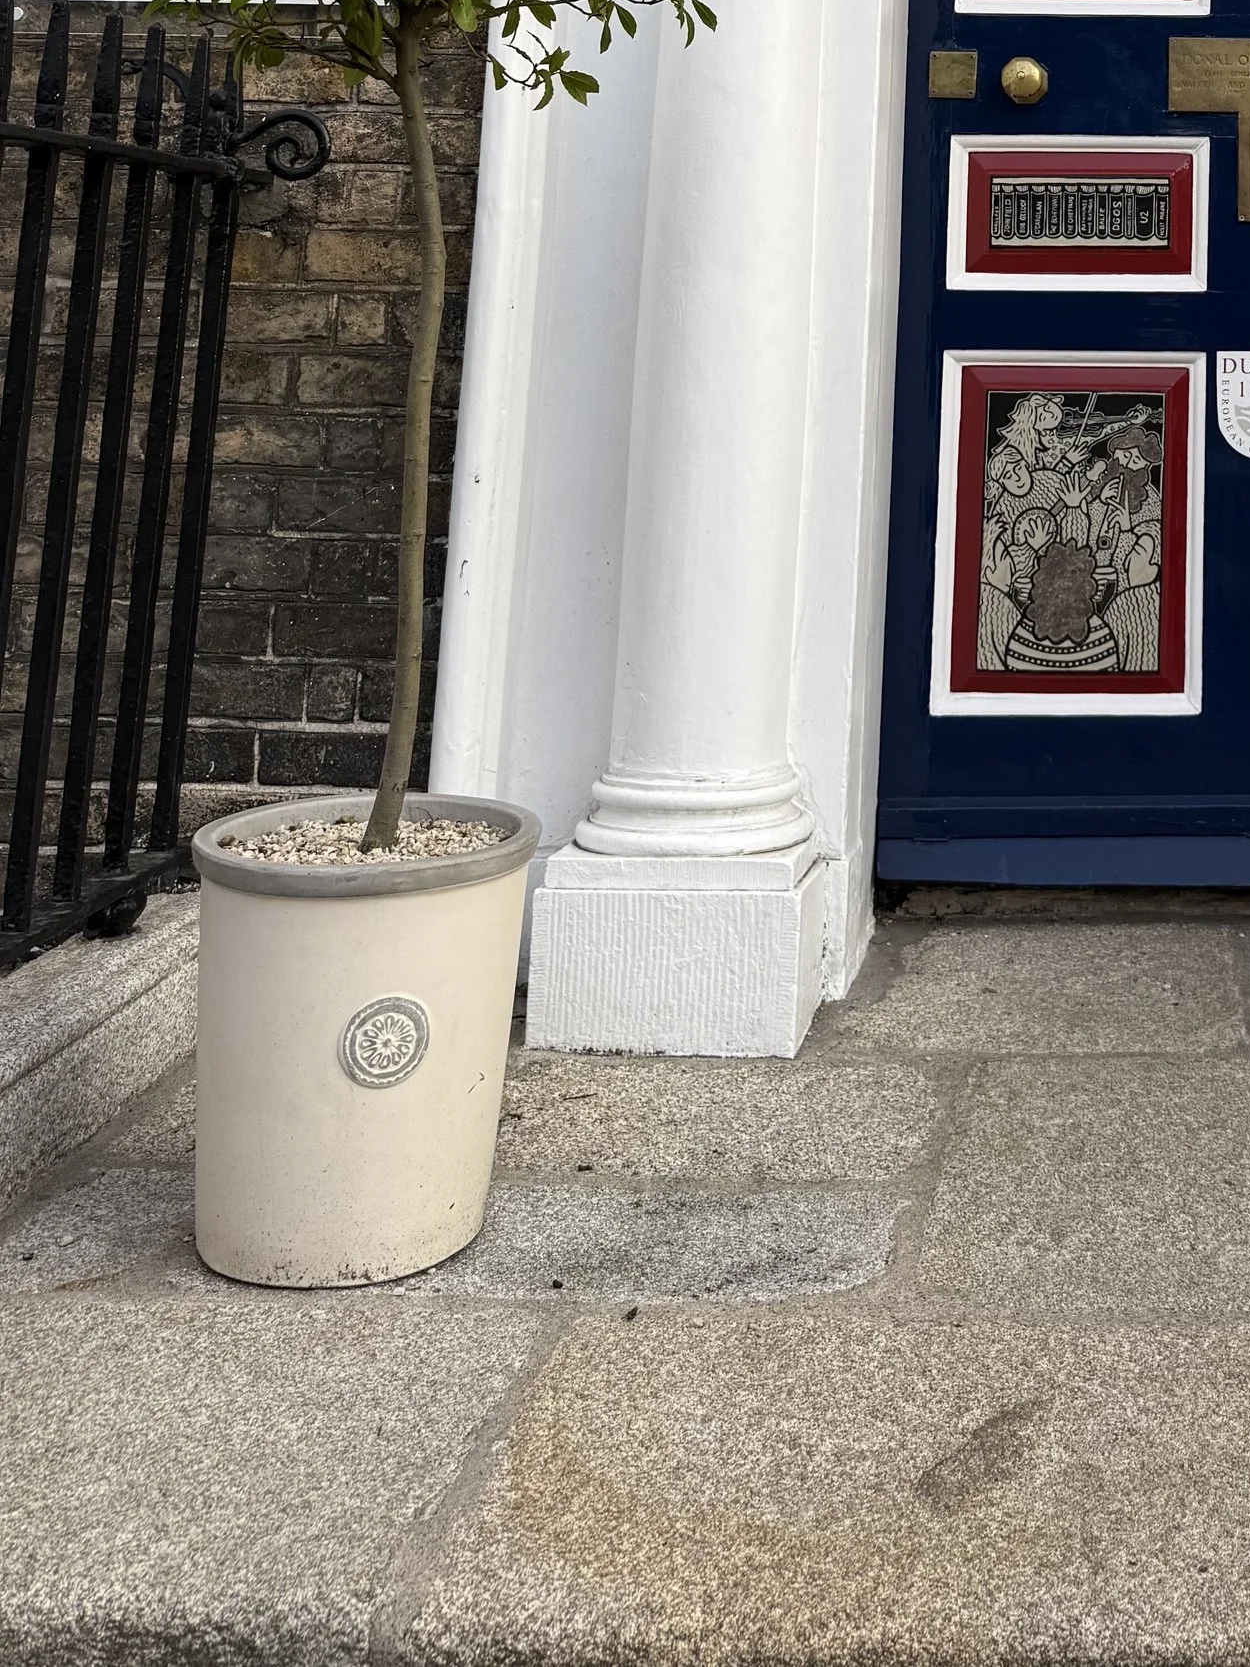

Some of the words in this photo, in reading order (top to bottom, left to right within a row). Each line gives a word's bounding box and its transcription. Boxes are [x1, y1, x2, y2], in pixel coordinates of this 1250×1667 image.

[1019, 199, 1027, 221] GELDOF
[1112, 201, 1122, 231] DGOS
[1140, 210, 1149, 224] U2
[1221, 379, 1245, 446] EUROPEAN
